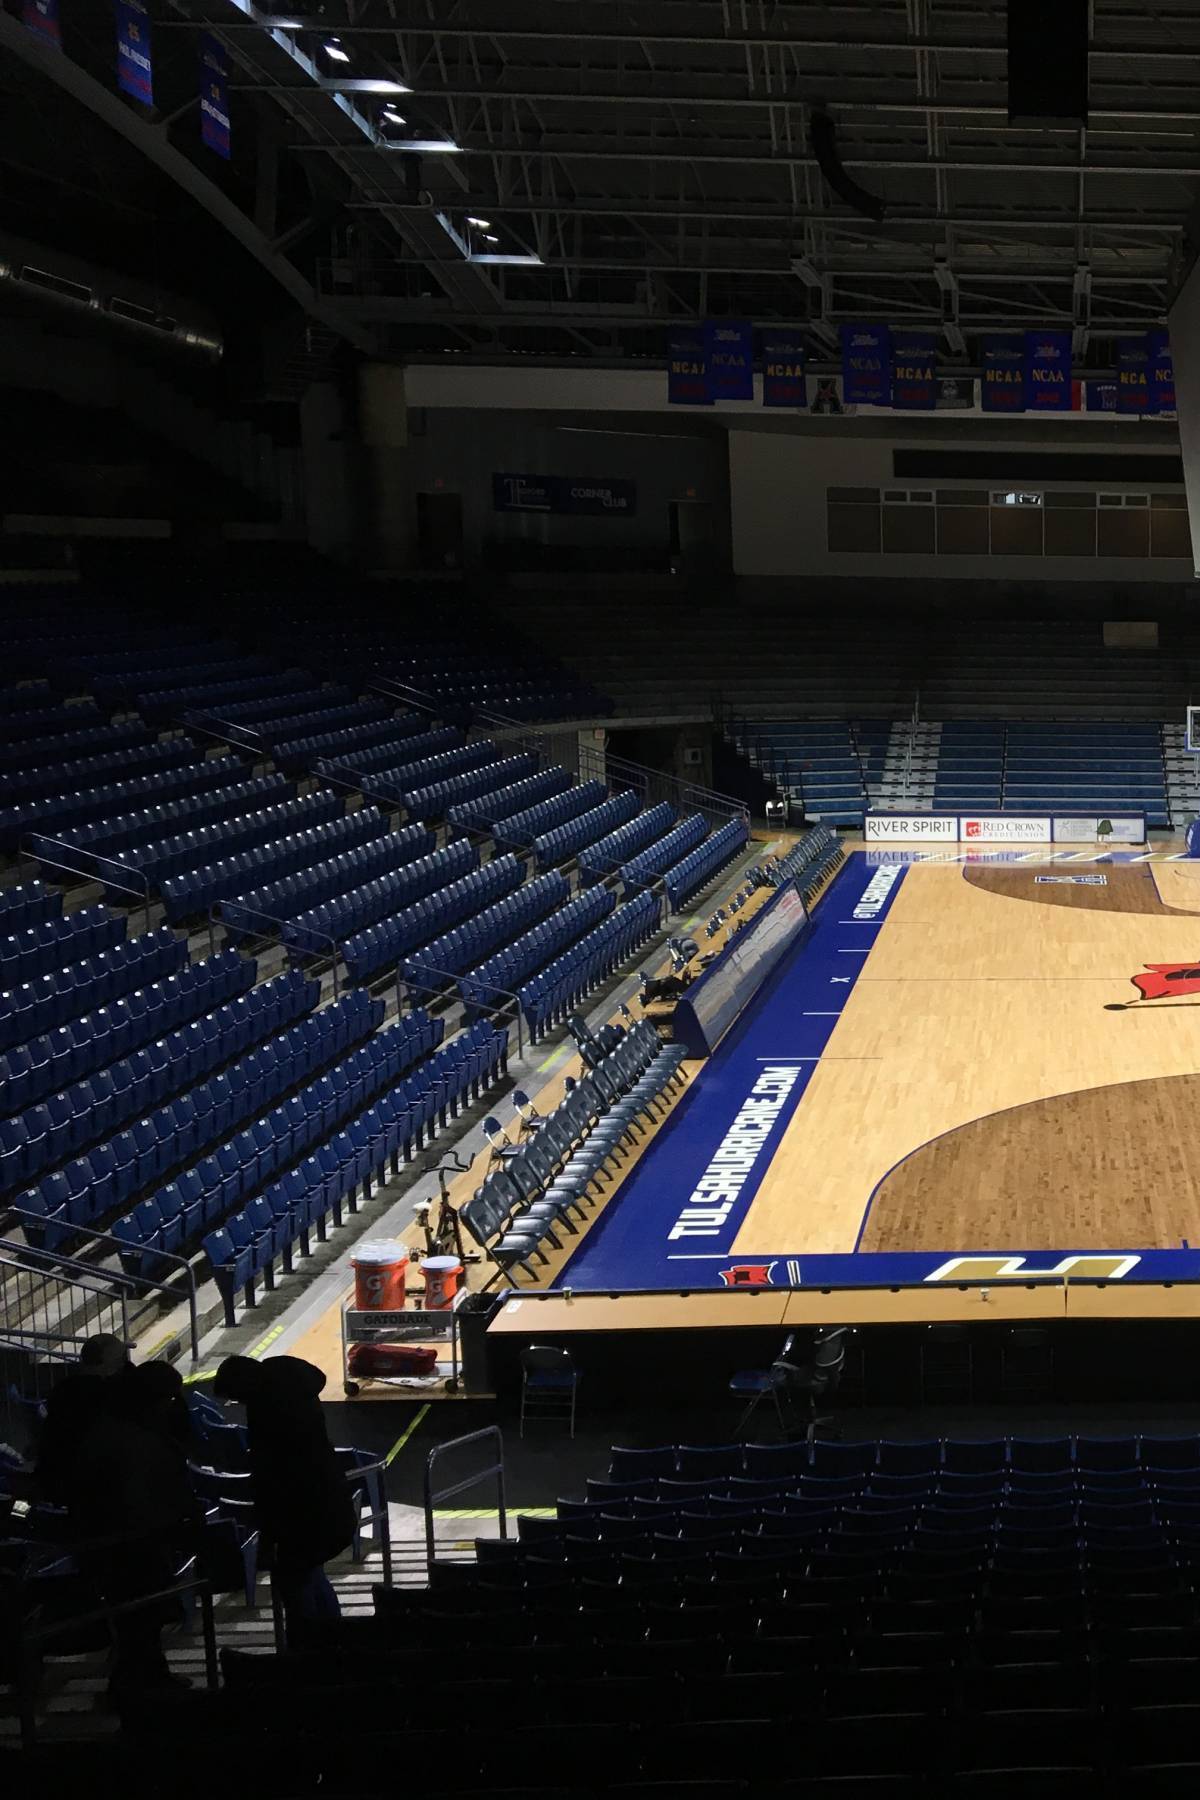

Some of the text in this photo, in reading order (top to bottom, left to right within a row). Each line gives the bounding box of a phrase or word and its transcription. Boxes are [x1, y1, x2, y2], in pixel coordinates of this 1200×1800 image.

[767, 364, 802, 377] NCAA
[896, 367, 933, 381] NCAA
[985, 369, 1022, 383] NCAA
[1032, 368, 1065, 383] NCAA
[1119, 372, 1147, 385] NCA
[868, 821, 952, 837] RIVER SPIRIT
[983, 822, 1044, 832] RED CROWN
[666, 1066, 802, 1241] TULSAHURRICANE.COM
[364, 1314, 431, 1325] GATORADE
